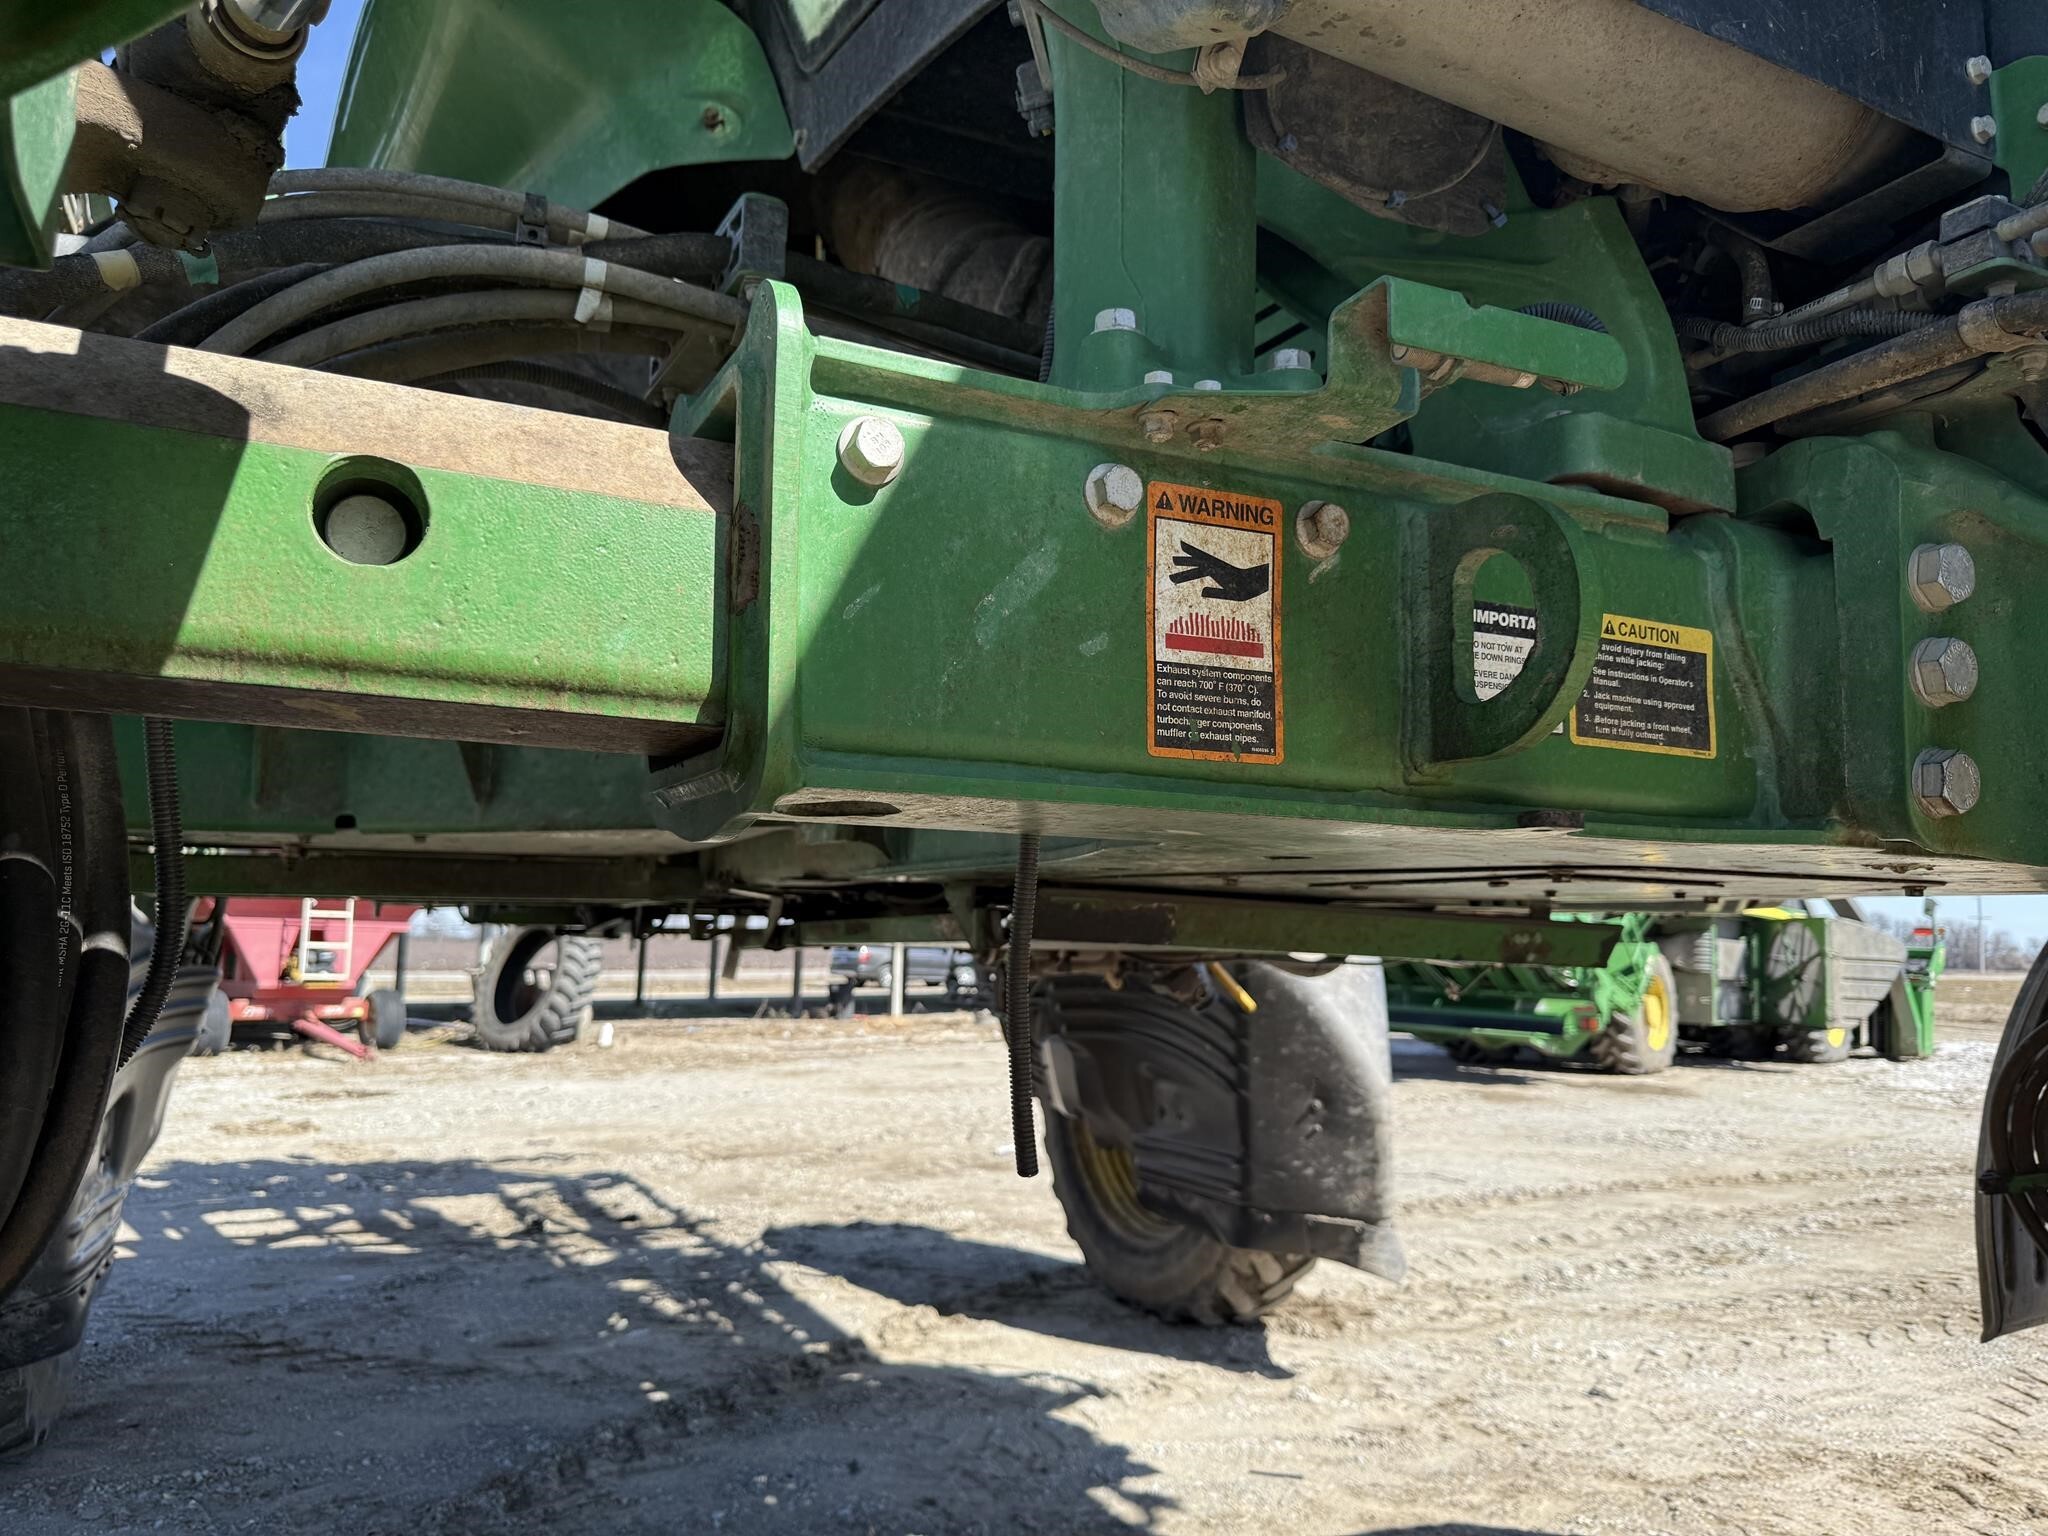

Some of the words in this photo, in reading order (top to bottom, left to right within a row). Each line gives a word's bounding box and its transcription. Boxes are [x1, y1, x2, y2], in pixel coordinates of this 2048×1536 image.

[1178, 493, 1275, 526] WARNING
[1473, 608, 1536, 631] IMPORTA
[1617, 621, 1680, 645] CAUTION
[1480, 641, 1495, 651] NOT
[1496, 642, 1513, 653] TOW
[1514, 646, 1524, 654] AT
[1601, 643, 1622, 653] avoid
[1623, 645, 1645, 658] injury
[1645, 648, 1663, 658] from
[1663, 651, 1687, 664] falling
[1481, 652, 1503, 662] DOWN
[1615, 654, 1636, 665] while
[1156, 663, 1191, 676] Exhaust
[1191, 668, 1222, 679] system
[1222, 671, 1272, 684] components
[1592, 666, 1607, 676] See
[1607, 668, 1650, 682] instructions
[1650, 674, 1657, 683] in
[1658, 675, 1695, 688] Operator's
[1592, 677, 1621, 687] Manual.
[1156, 678, 1172, 686] can
[1173, 679, 1197, 689] reach
[1199, 680, 1217, 690] 700°
[1218, 682, 1224, 691] F
[1156, 689, 1167, 698] To
[1168, 690, 1193, 701] avoid
[1194, 694, 1222, 703] severe
[1250, 697, 1262, 707] do
[1582, 689, 1591, 698] 2.
[1593, 691, 1611, 700] Jack
[1611, 694, 1642, 705] machine
[1642, 698, 1663, 709] using
[1663, 701, 1695, 712] approved
[1156, 702, 1171, 711] not
[1171, 704, 1203, 714] contact
[1203, 706, 1236, 717] exhaust
[1594, 702, 1634, 714] equipment.
[1156, 715, 1211, 729] turbochger
[1584, 714, 1592, 723] 3.
[1594, 714, 1619, 726] Before
[1620, 717, 1646, 730] jacking
[1652, 721, 1670, 732] front
[1156, 728, 1187, 738] muffler
[1199, 731, 1232, 742] exhaust
[1595, 725, 1611, 735] turn
[1611, 726, 1618, 735] it
[1618, 727, 1635, 739] fully
[59, 793, 73, 814] Type
[60, 815, 73, 846] 18752
[62, 848, 73, 864] ISO
[63, 865, 73, 895] Meets
[58, 936, 69, 965] MSHA
